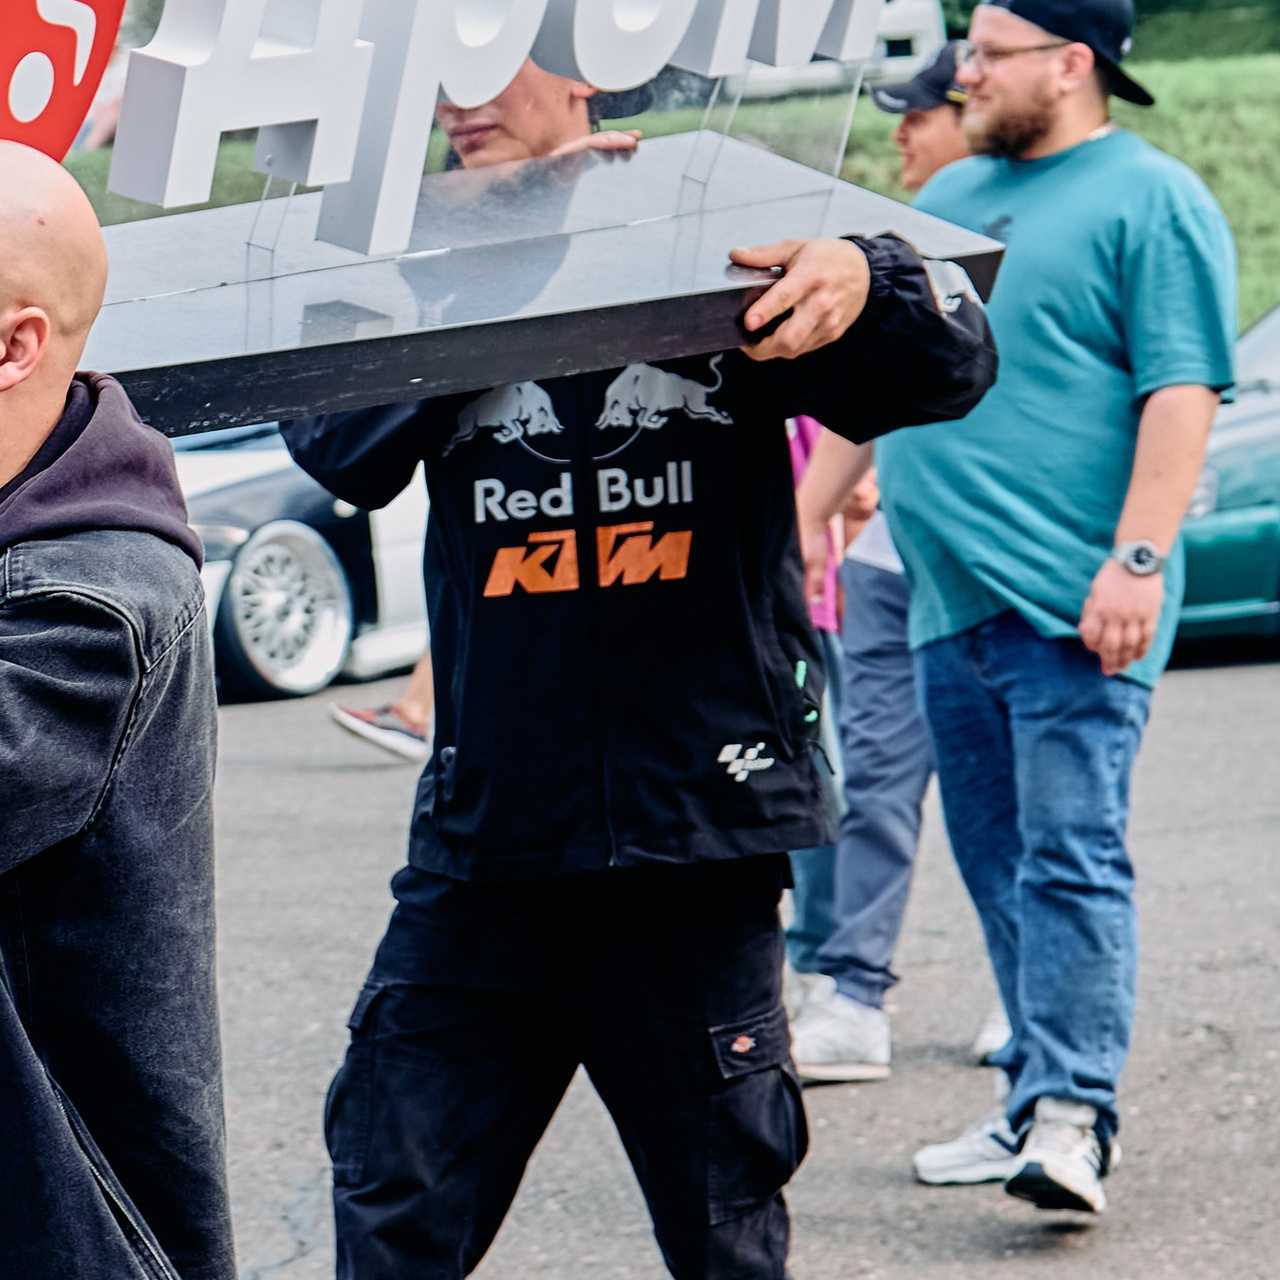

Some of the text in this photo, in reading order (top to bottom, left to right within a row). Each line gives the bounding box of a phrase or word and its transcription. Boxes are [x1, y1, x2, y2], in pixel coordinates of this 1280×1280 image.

[474, 460, 693, 523] Red Bull
[483, 520, 693, 597] KTM
